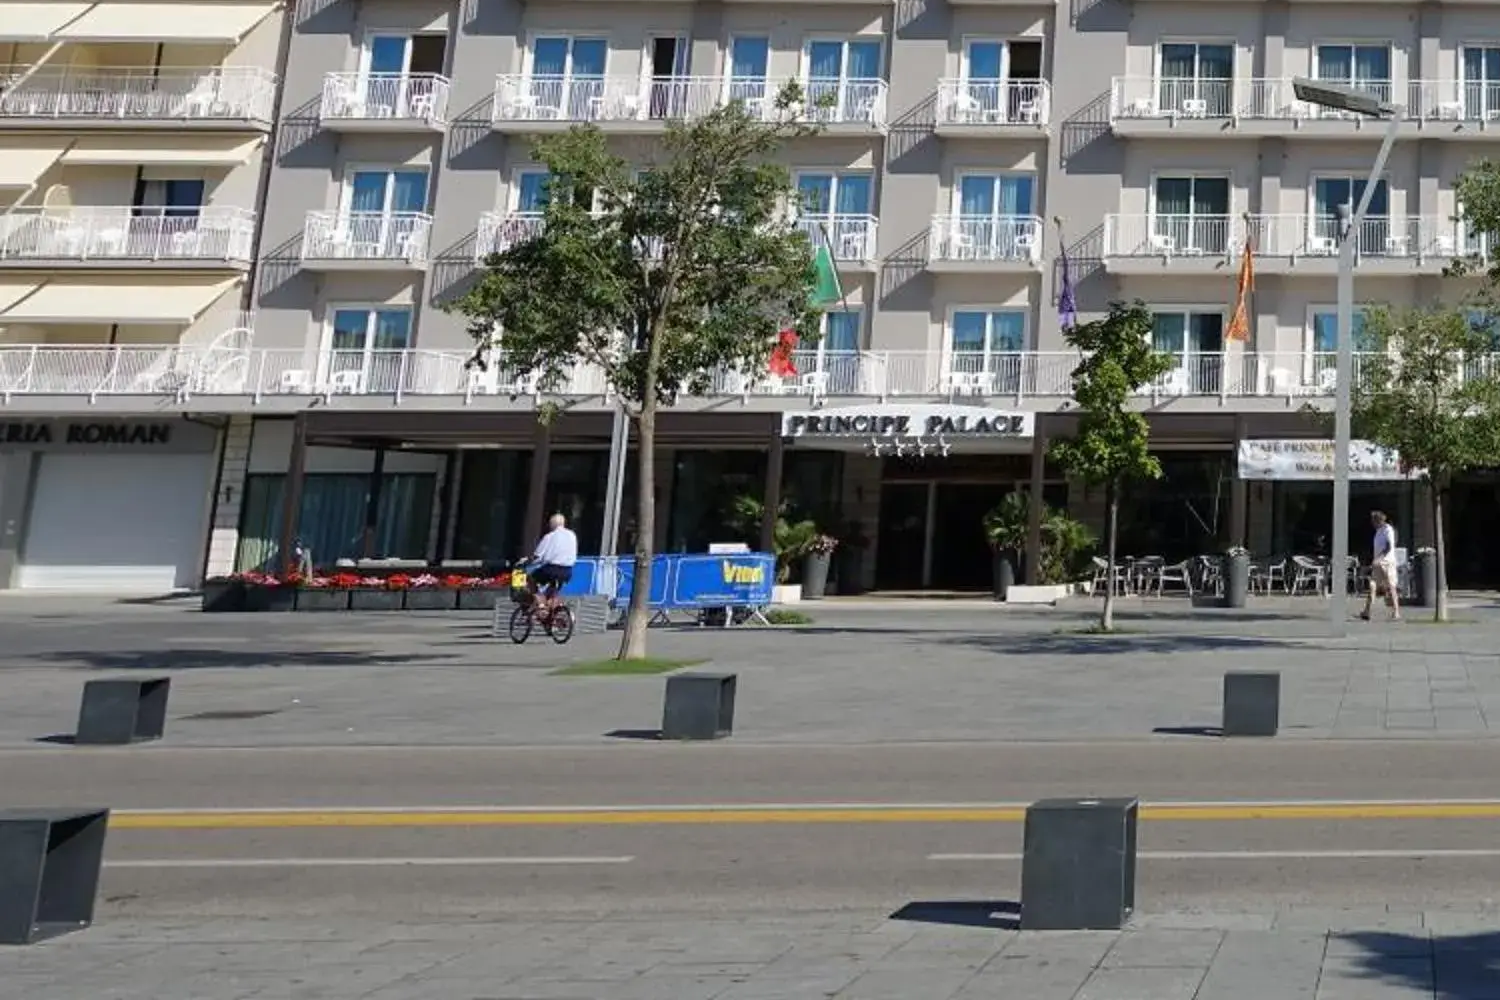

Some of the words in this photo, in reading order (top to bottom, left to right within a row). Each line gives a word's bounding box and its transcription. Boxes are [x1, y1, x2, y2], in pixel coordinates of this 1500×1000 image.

[66, 423, 174, 444] ROMAN
[788, 414, 910, 434] PRINCIPE
[924, 414, 1025, 434] PALACE
